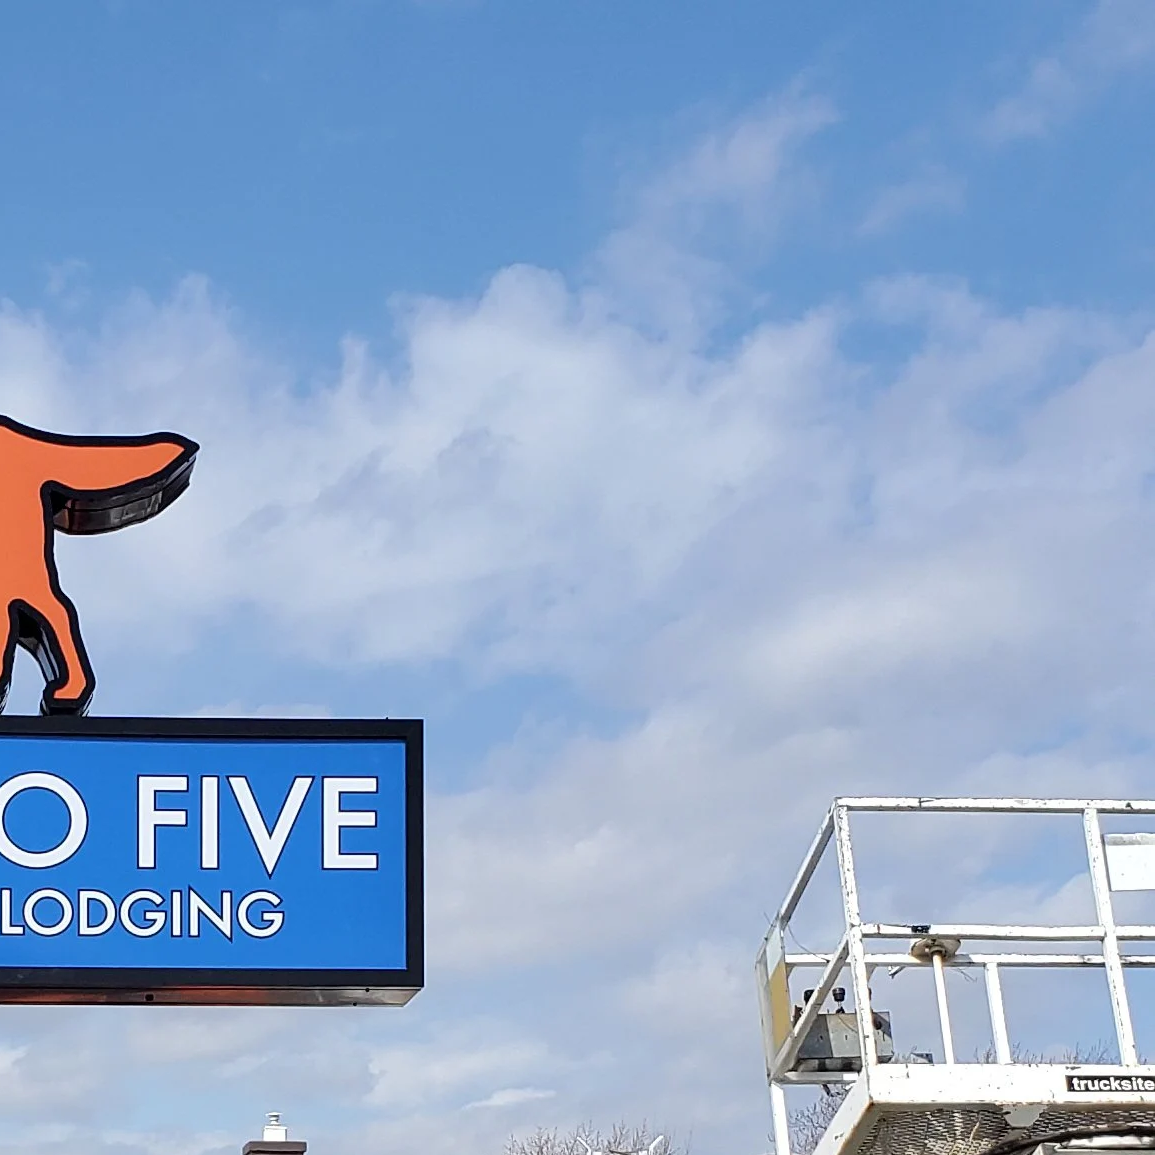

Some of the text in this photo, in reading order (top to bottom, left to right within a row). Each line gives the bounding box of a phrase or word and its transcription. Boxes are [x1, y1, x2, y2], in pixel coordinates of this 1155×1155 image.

[137, 774, 378, 879] FIVE
[0, 885, 285, 943] LODGING
[1072, 1076, 1155, 1091] trucksite
